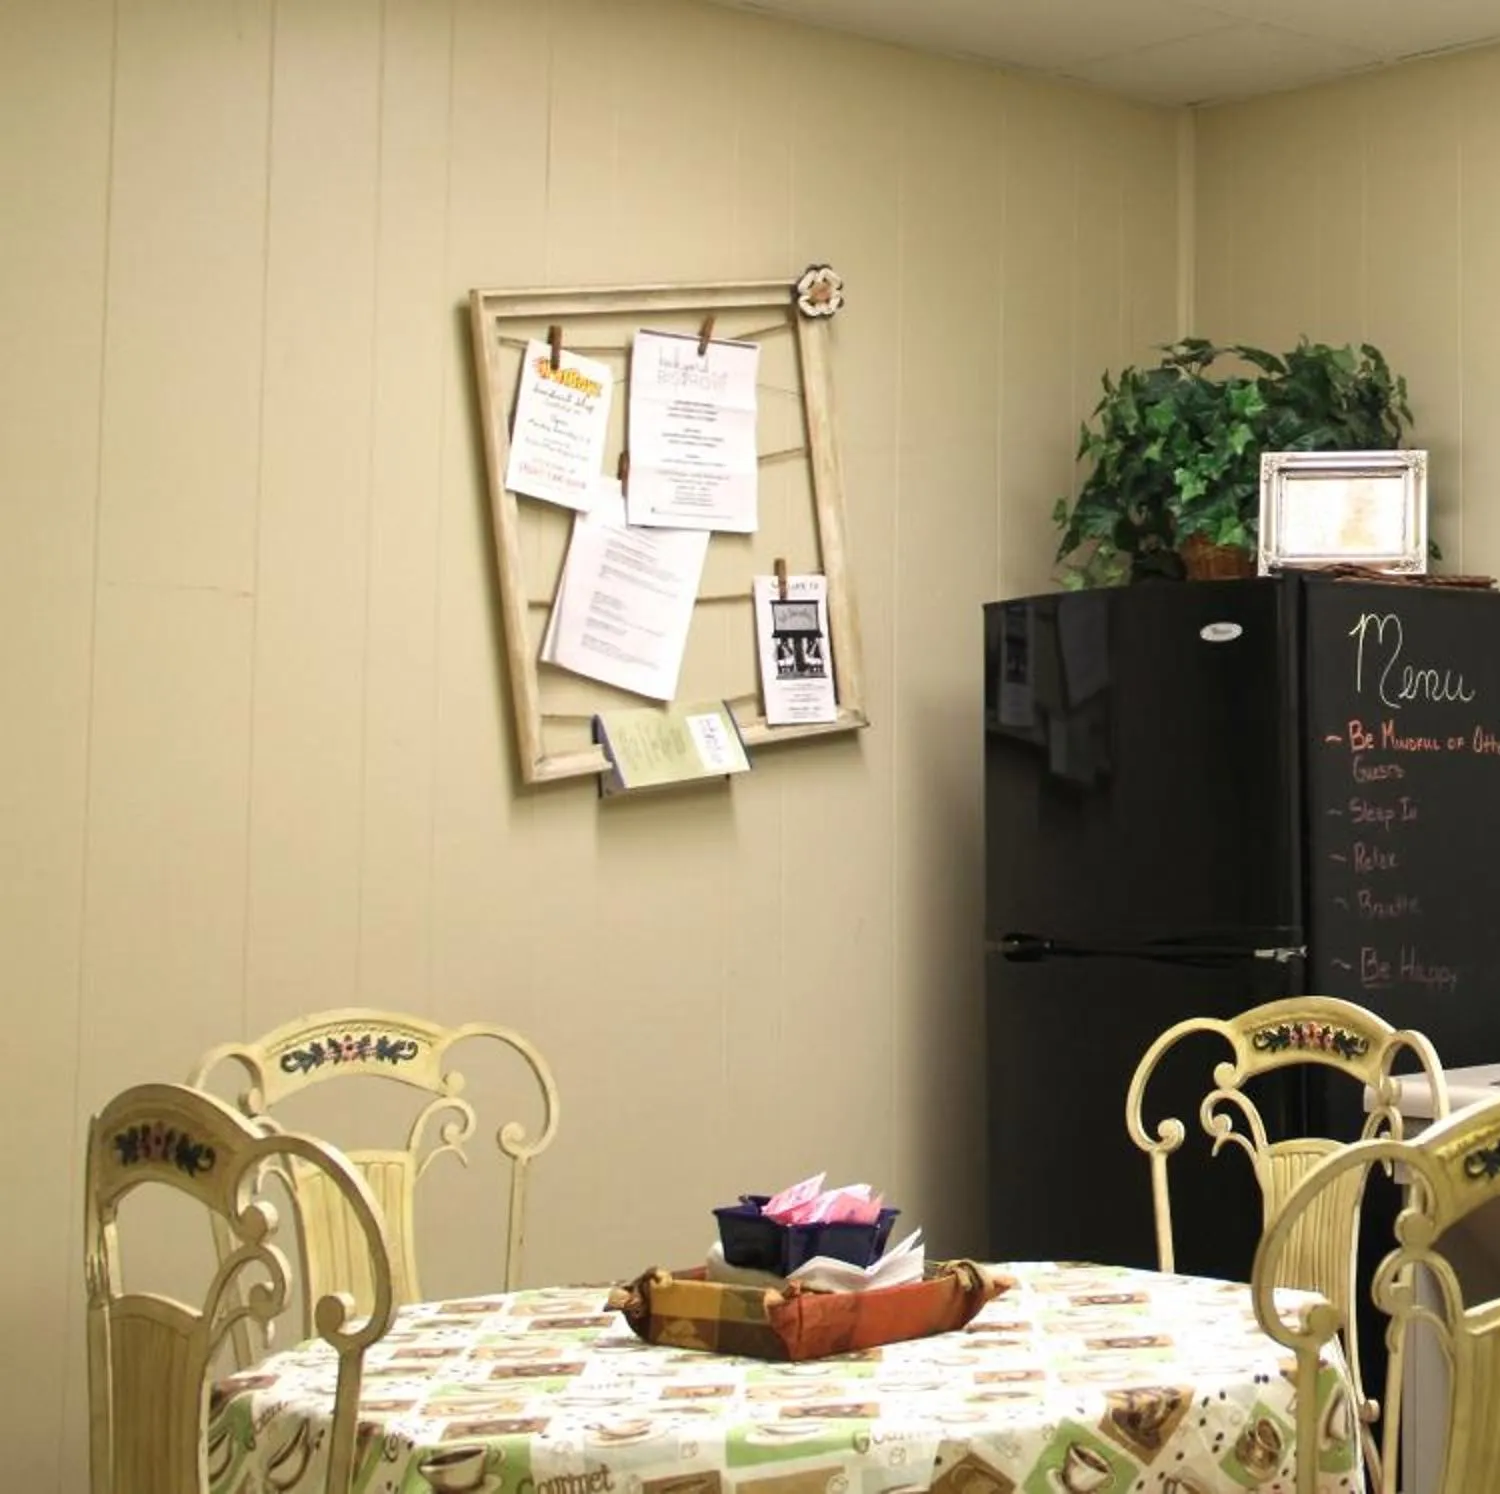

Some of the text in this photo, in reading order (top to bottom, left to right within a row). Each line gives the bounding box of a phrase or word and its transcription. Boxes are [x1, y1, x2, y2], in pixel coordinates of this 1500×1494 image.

[1349, 613, 1476, 709] Menu
[1349, 719, 1375, 751] Be
[1361, 947, 1391, 983] Be
